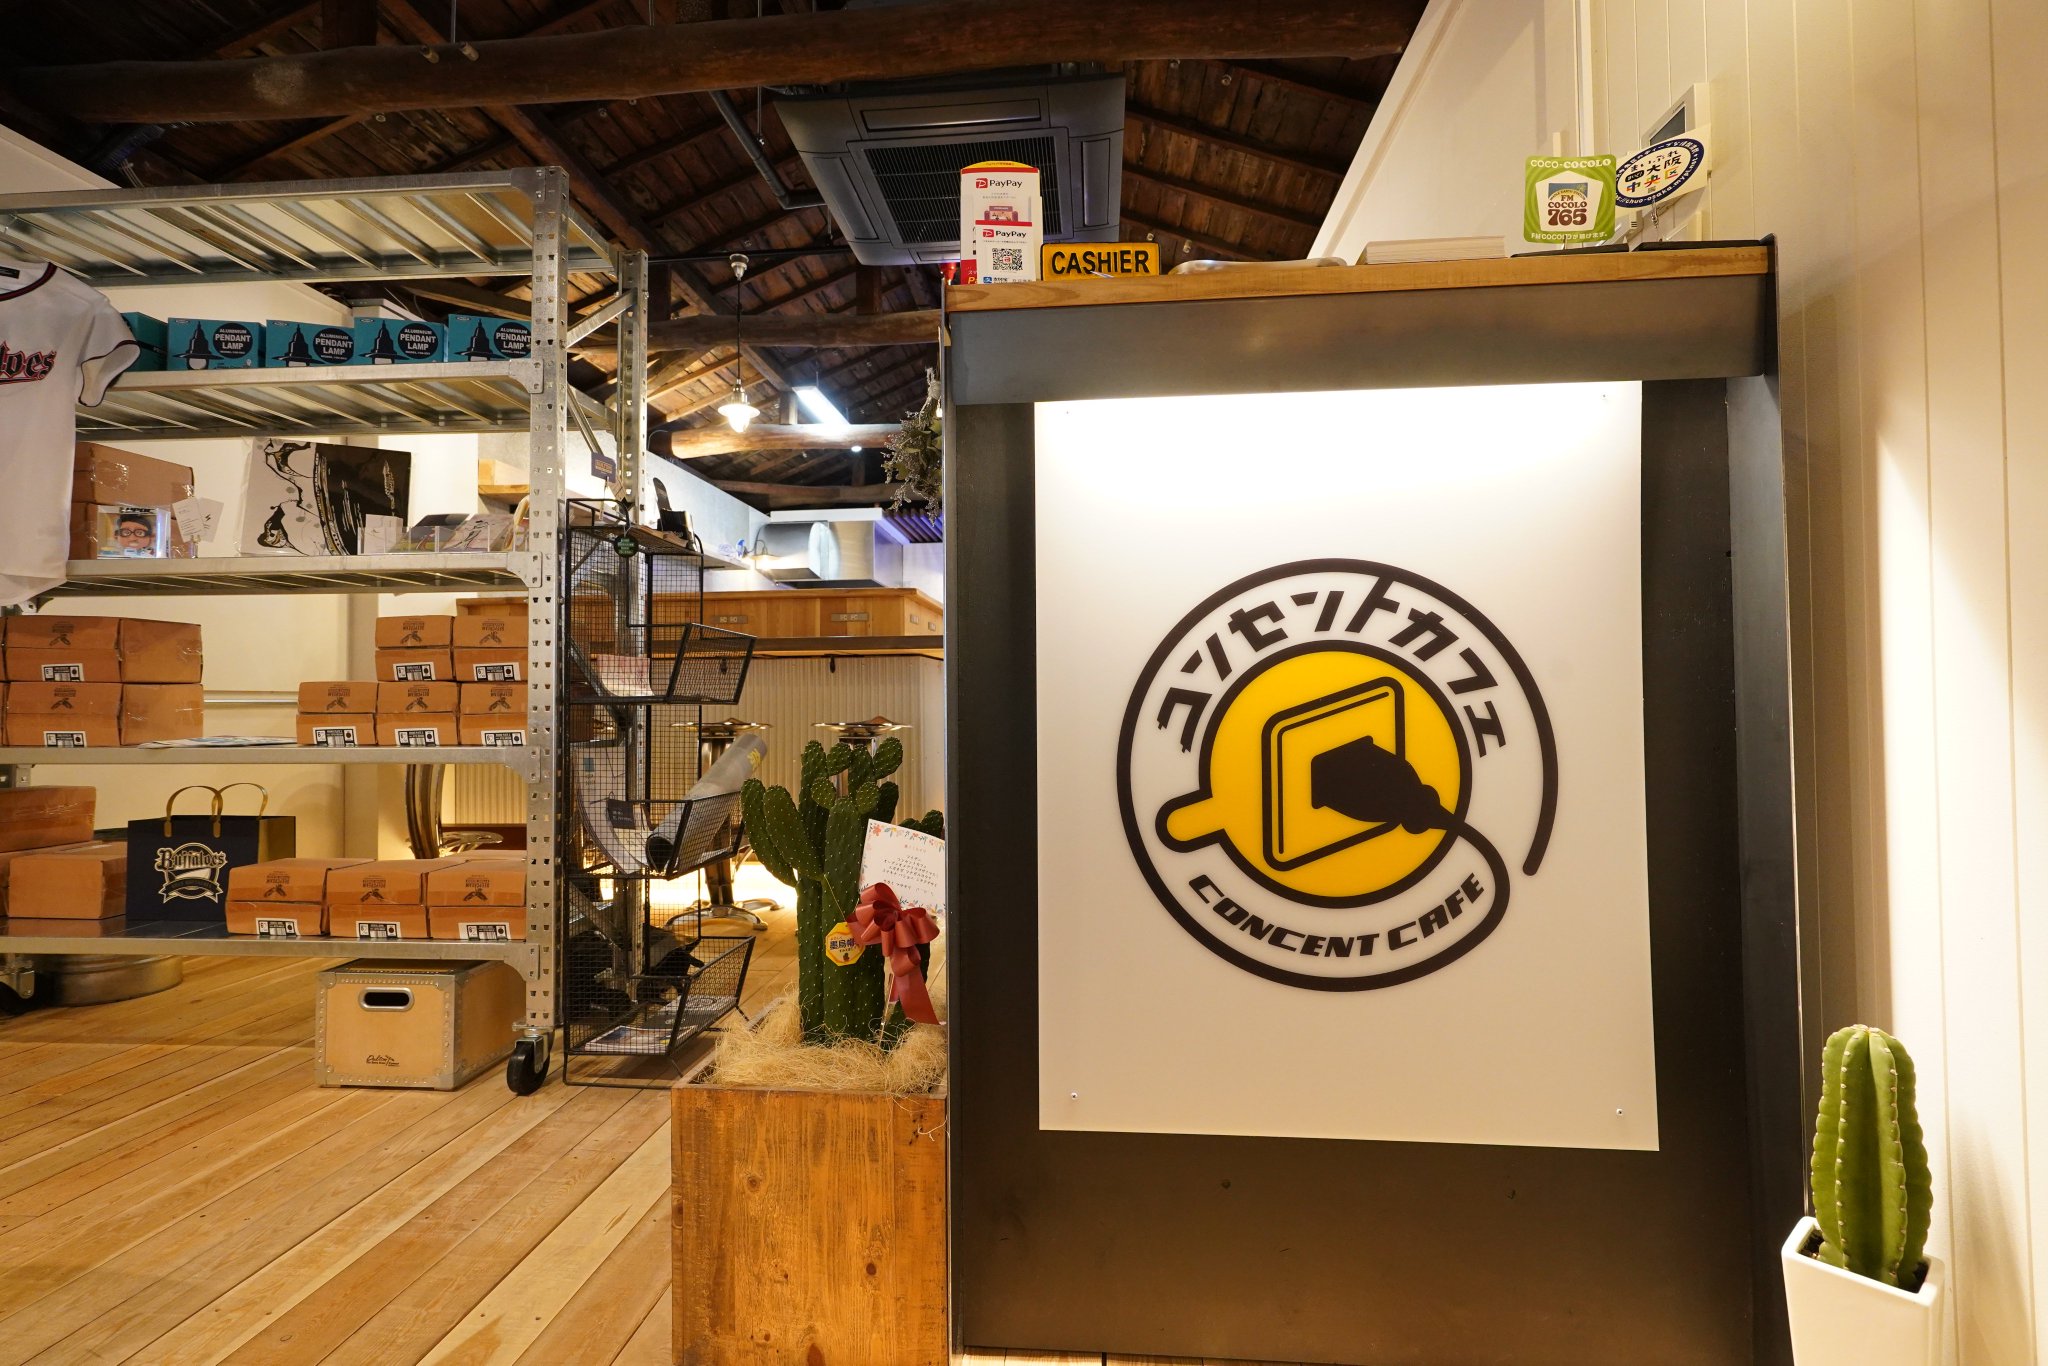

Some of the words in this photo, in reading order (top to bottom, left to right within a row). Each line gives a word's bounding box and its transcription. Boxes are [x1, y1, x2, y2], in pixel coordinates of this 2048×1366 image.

[1530, 159, 1611, 169] COCO-COCOLO
[1646, 155, 1682, 175] 大阪
[989, 179, 1023, 188] PayPay
[1626, 167, 1679, 193] 中央区
[1548, 201, 1587, 209] COCOLO
[1548, 208, 1587, 226] 765
[995, 230, 1027, 239] PayPay
[1051, 250, 1150, 275] CASHIER
[215, 333, 251, 343] PENDANT
[400, 333, 437, 343] PENDANT
[495, 333, 531, 343] PENDANT
[222, 342, 244, 350] LAMP
[315, 338, 353, 349] PENDANT
[407, 342, 429, 350] LAMP
[503, 341, 525, 349] LAMP
[322, 346, 346, 355] LAMP
[1157, 576, 1506, 758] コンセントカフェ
[155, 847, 229, 871] Buffaloes
[1189, 874, 1380, 957] CONCENT
[1387, 872, 1485, 951] CAFE
